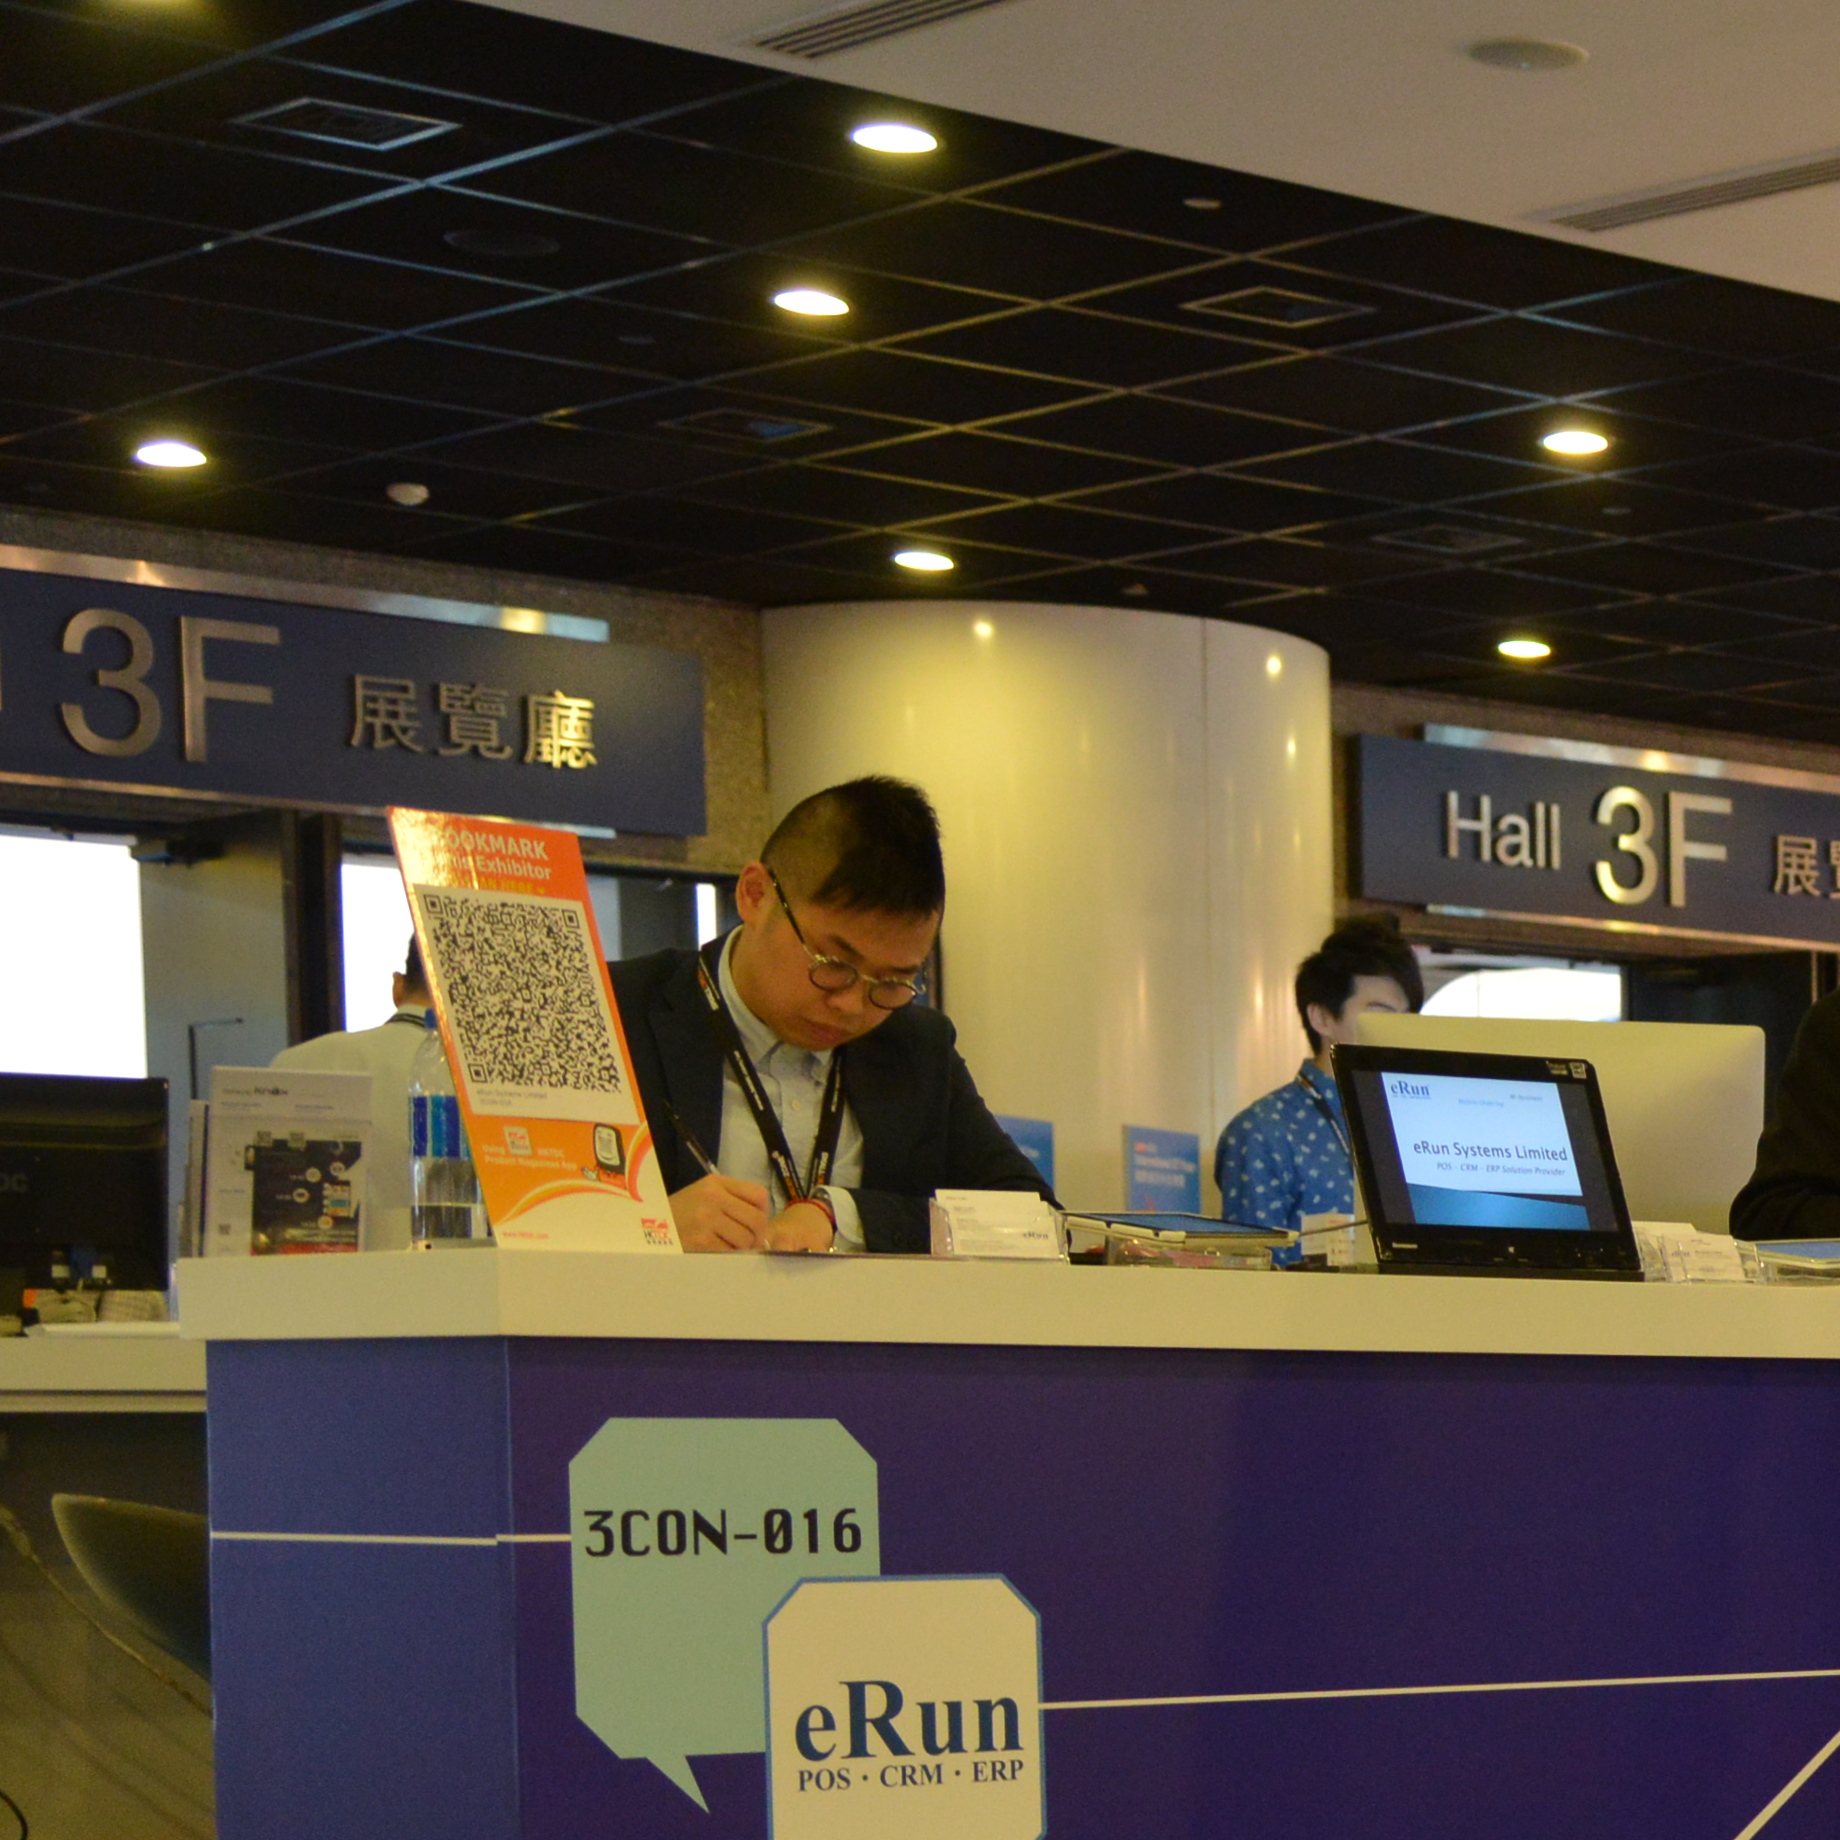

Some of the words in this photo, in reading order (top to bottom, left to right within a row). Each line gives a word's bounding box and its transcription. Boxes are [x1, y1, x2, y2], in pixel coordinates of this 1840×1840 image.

[58, 607, 281, 763] 3F
[349, 673, 598, 771] 展覽廳
[475, 855, 552, 880] Exhibitor
[1445, 790, 1560, 870] Hall
[1594, 786, 1733, 908] 3F
[1390, 1080, 1431, 1097] eRun
[1413, 1140, 1450, 1156] eRun
[1453, 1141, 1512, 1160] Systems
[1516, 1145, 1568, 1162] Limited
[1486, 1164, 1501, 1174] ERP
[1502, 1165, 1533, 1175] Solution
[1535, 1167, 1566, 1177] Provider
[584, 1507, 863, 1558] 3CON-016
[794, 1679, 1025, 1762] eRun
[797, 1768, 852, 1792] POS
[879, 1763, 944, 1789] CRM
[971, 1759, 1024, 1784] ERP
